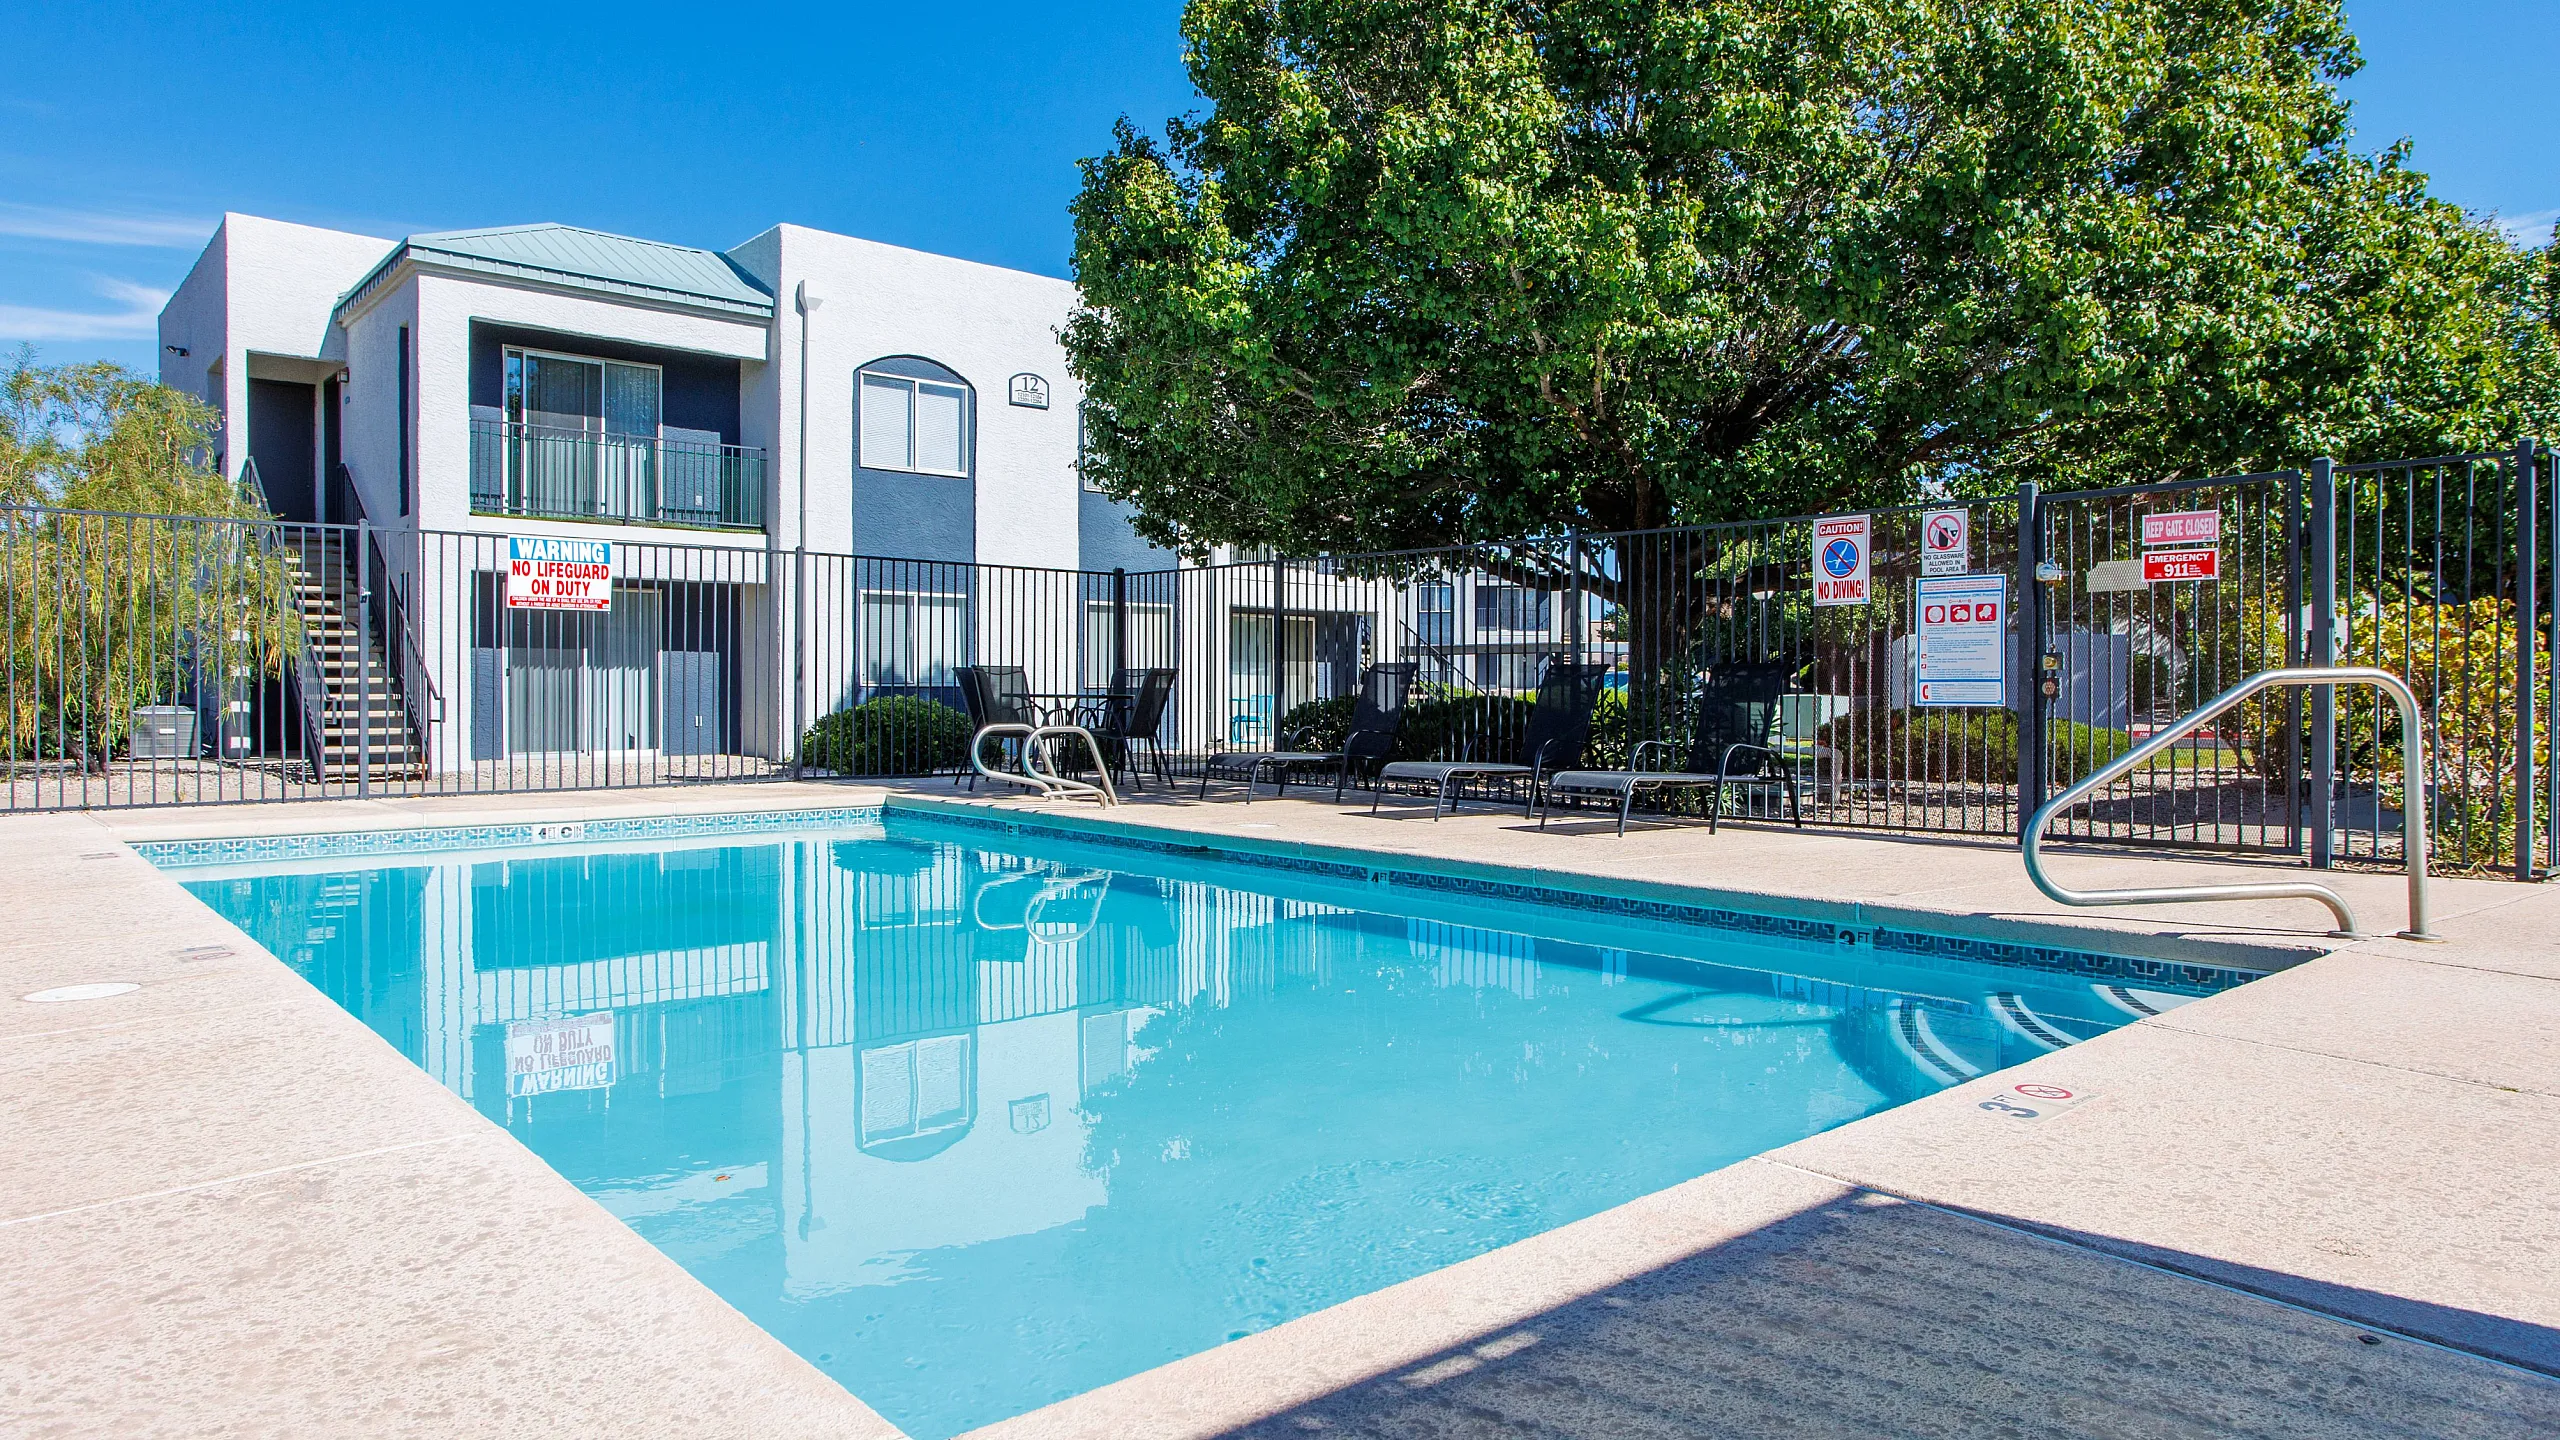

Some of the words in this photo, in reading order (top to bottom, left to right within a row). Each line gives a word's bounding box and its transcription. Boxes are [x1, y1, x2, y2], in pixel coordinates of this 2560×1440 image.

[1022, 376, 1039, 391] 12
[1819, 522, 1863, 535] CAUTION!
[2146, 521, 2163, 539] KEEP
[2166, 520, 2184, 537] GATE
[2186, 517, 2215, 536] CLOSED
[516, 538, 605, 563] WARNING
[1933, 552, 1965, 560] GLASSWARE
[2148, 553, 2210, 564] EMERGENCY
[512, 560, 531, 576] NO
[538, 562, 609, 580] LIFEGUARD
[2163, 563, 2189, 578] 911
[531, 579, 549, 595] ON
[556, 580, 590, 597] DUTY
[1818, 581, 1830, 600] NO
[1833, 579, 1864, 599] DIVING!
[1380, 872, 1387, 882] FT
[1858, 931, 1870, 943] FT
